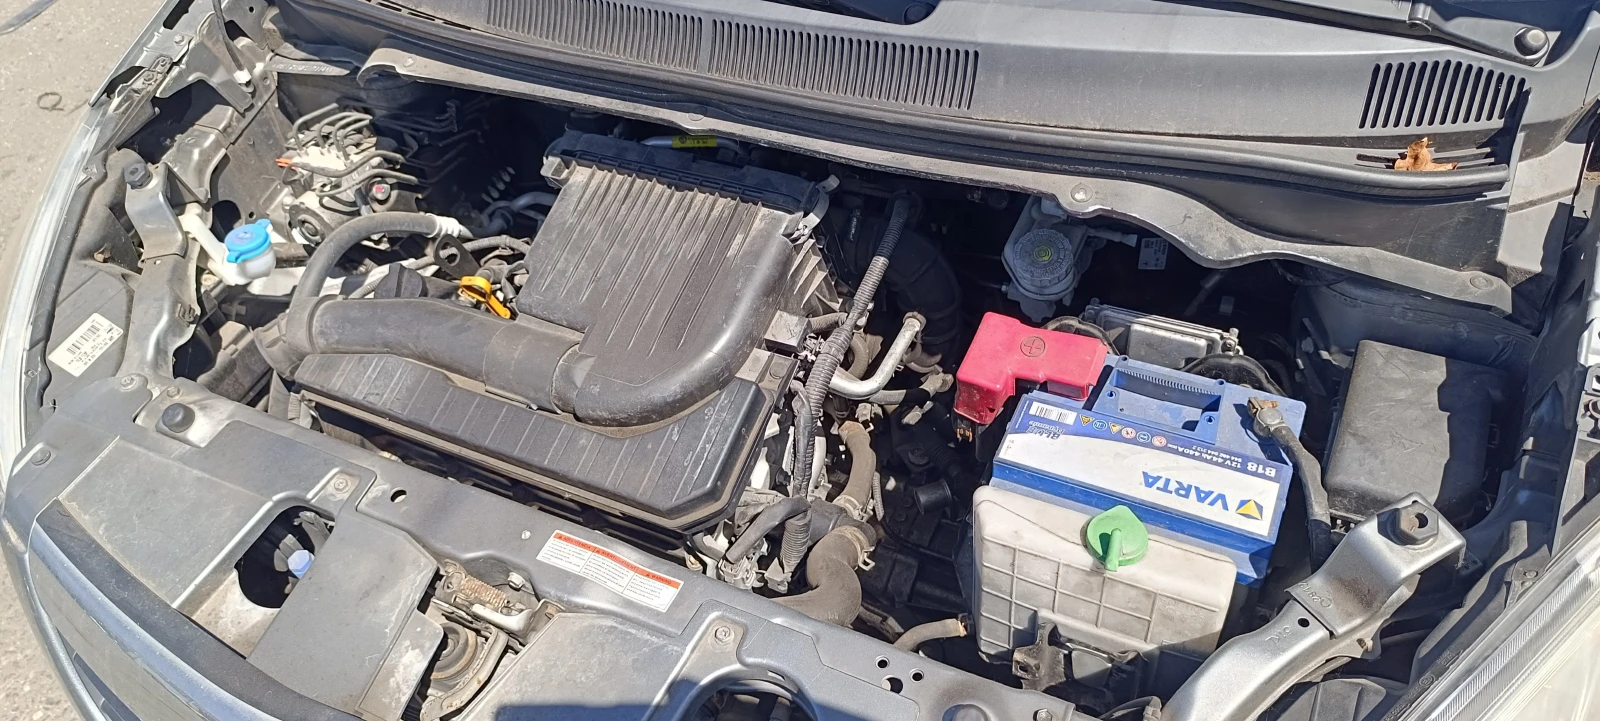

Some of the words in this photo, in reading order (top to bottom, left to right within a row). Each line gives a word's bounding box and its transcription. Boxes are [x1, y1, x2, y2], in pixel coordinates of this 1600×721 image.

[1026, 426, 1060, 440] BLUE
[1201, 453, 1225, 464] 44Ah
[1224, 460, 1242, 469] 12V
[1247, 461, 1277, 477] B18
[1142, 471, 1229, 512] VARTA
